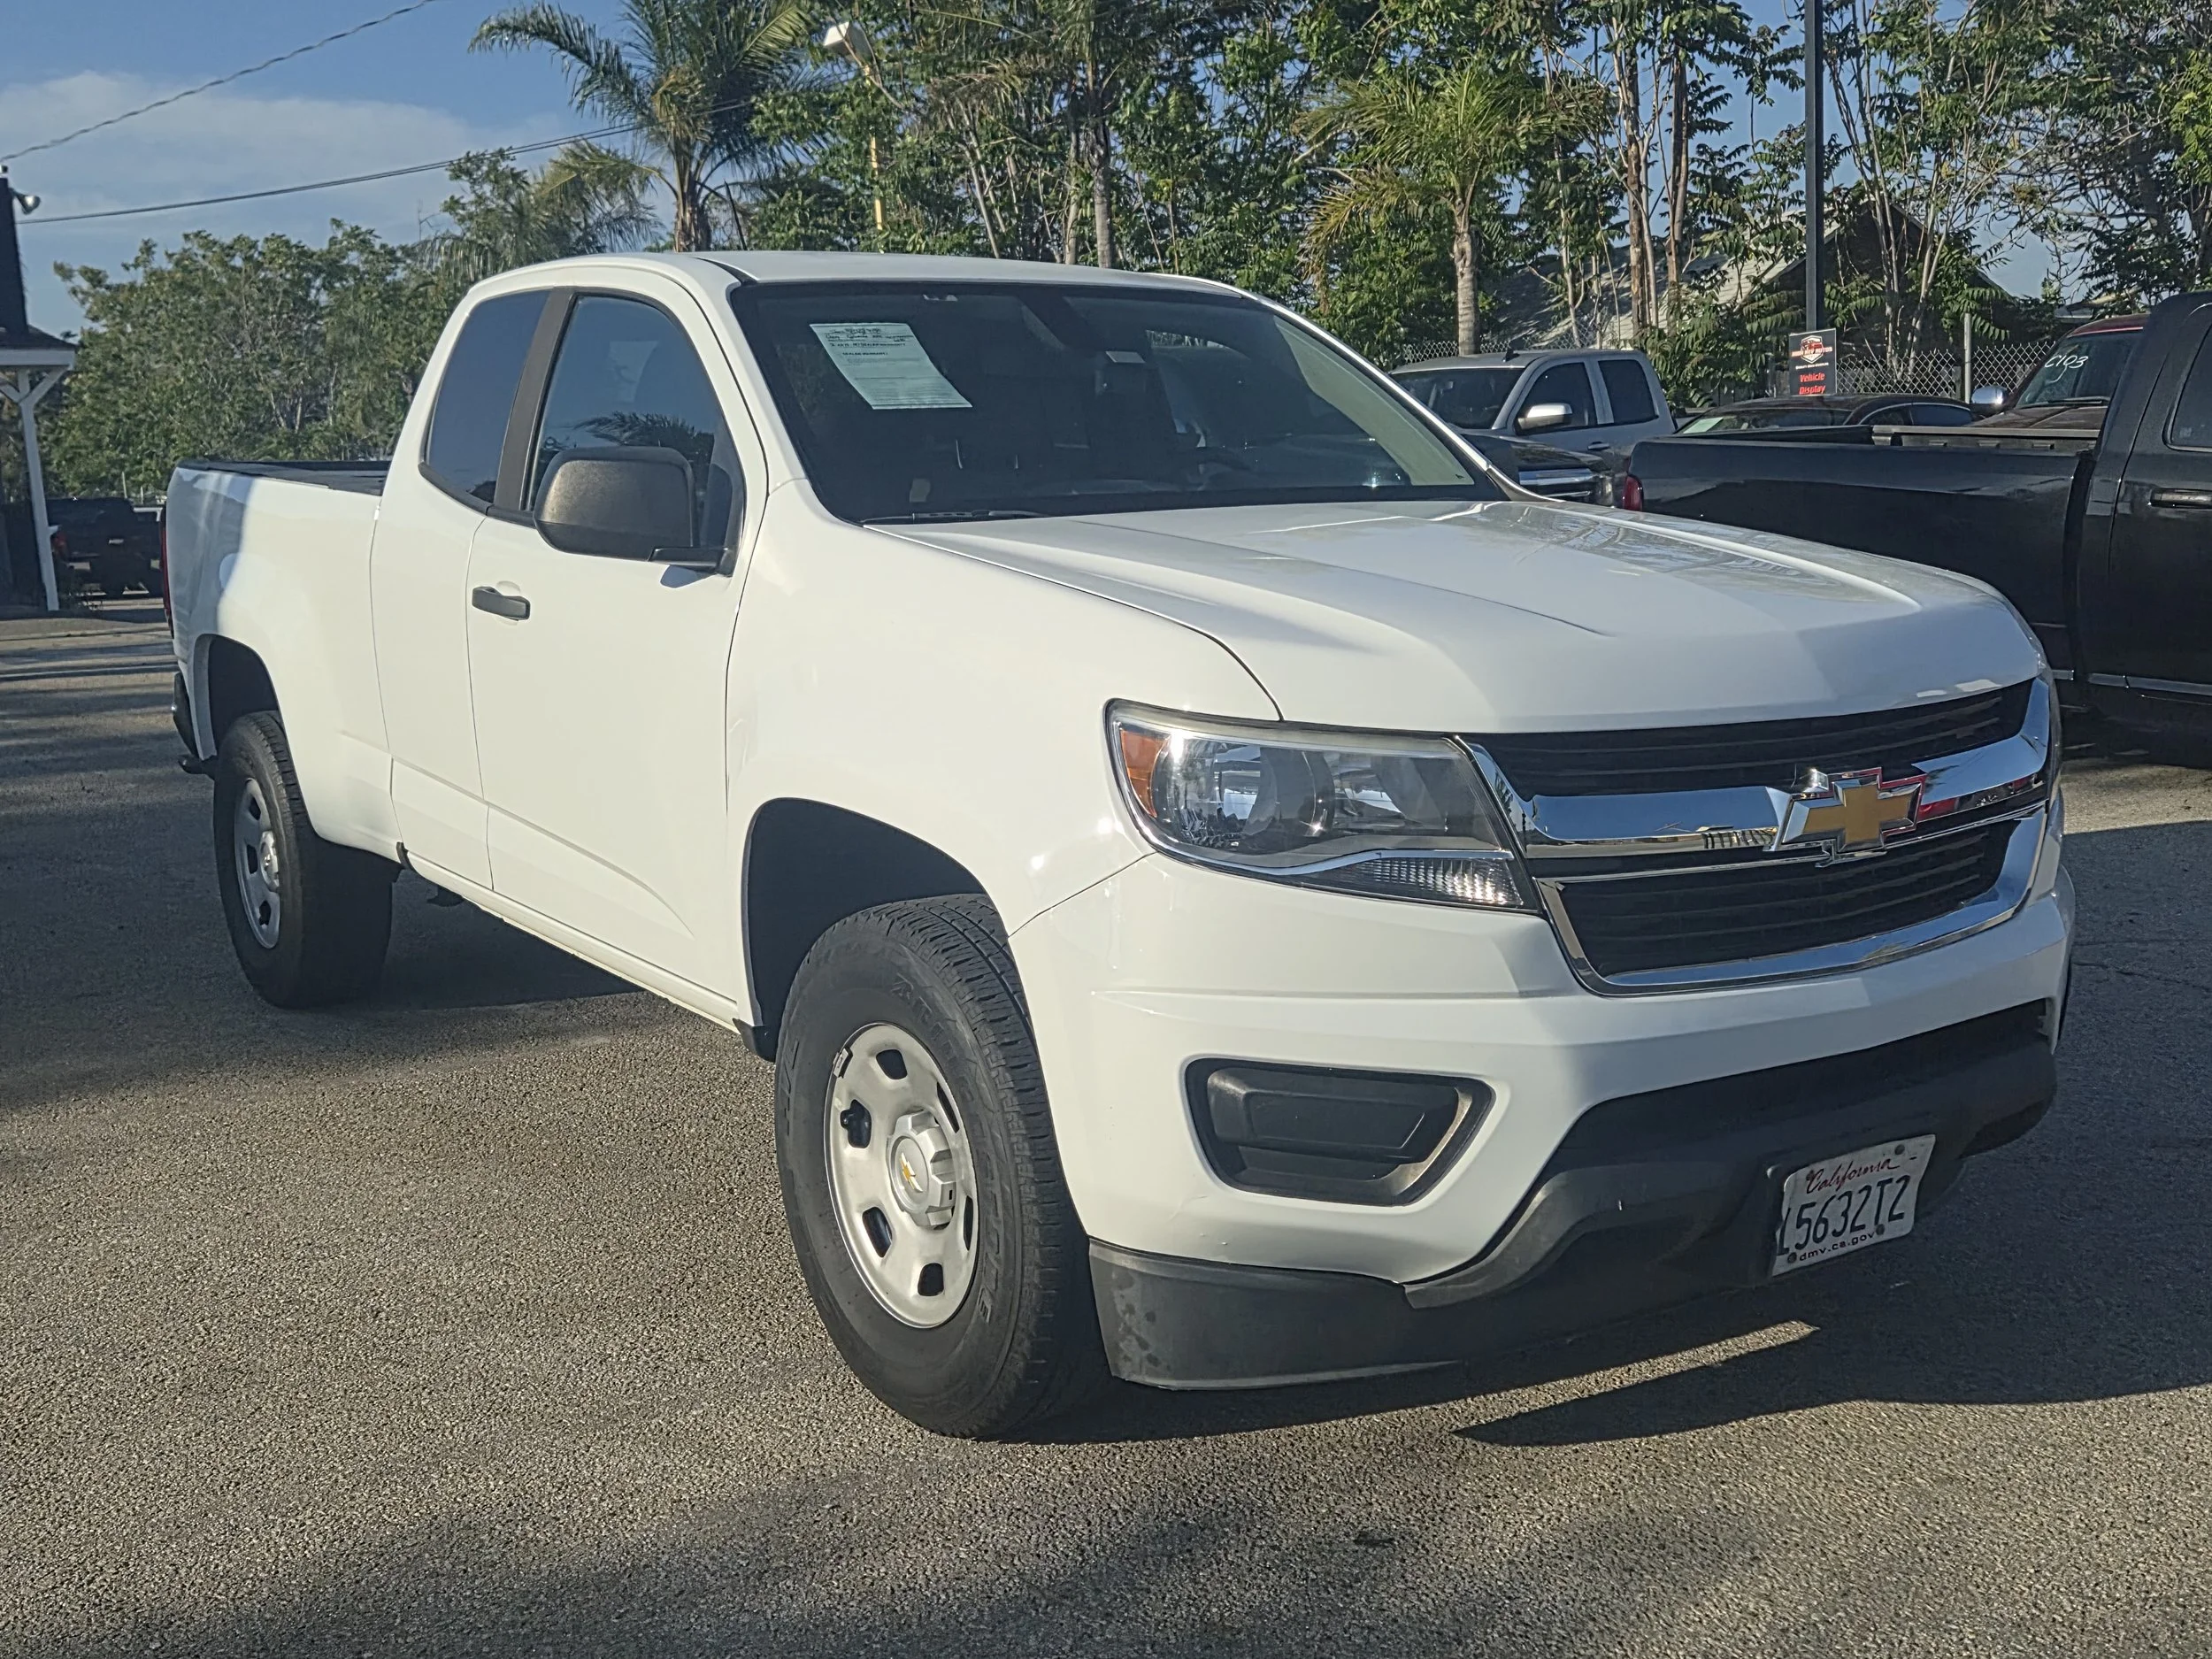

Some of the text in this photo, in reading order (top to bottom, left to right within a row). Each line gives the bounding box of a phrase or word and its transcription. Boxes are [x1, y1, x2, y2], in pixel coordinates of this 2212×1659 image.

[1800, 373, 1825, 382] Vehicle
[1799, 385, 1826, 396] Display
[1806, 1159, 1901, 1195] California
[1799, 1231, 1876, 1262] dmv.ca.gov
